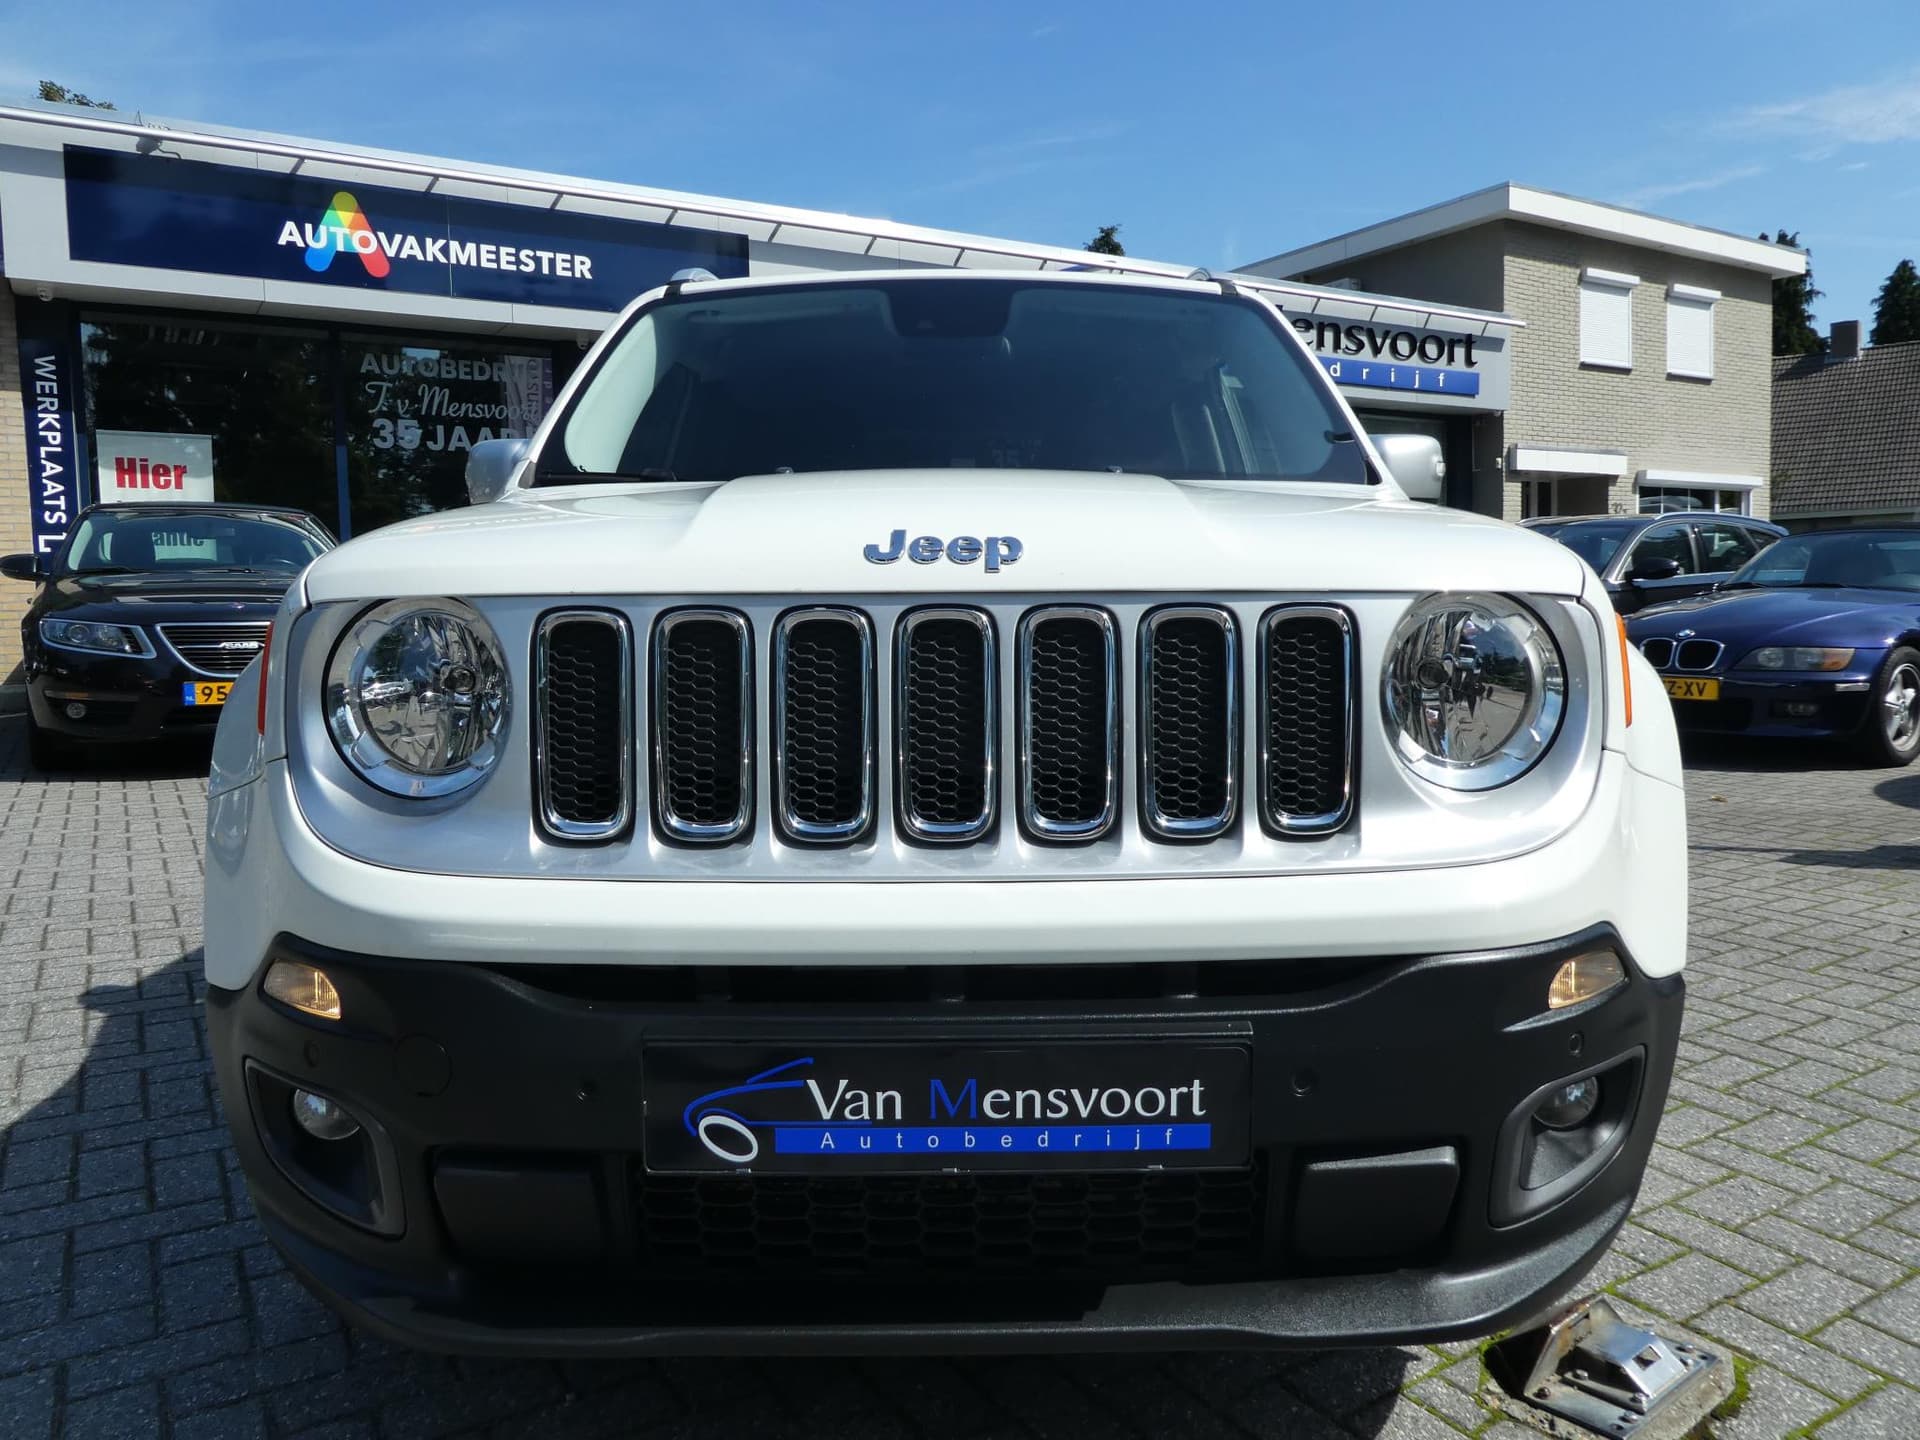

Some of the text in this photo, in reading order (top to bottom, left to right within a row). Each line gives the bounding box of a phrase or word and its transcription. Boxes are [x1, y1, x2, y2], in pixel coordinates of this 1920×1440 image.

[278, 220, 593, 280] AUTOVAKMEESTER
[1276, 304, 1479, 369] ensvoort
[33, 355, 67, 525] WERKPLAATS
[372, 418, 421, 450] 35
[115, 456, 188, 489] Hier
[863, 529, 1024, 574] Jeep
[201, 685, 228, 702] 95
[806, 1078, 1207, 1121] Van Mensvoort
[820, 1128, 1174, 1150] Autobedrijf
